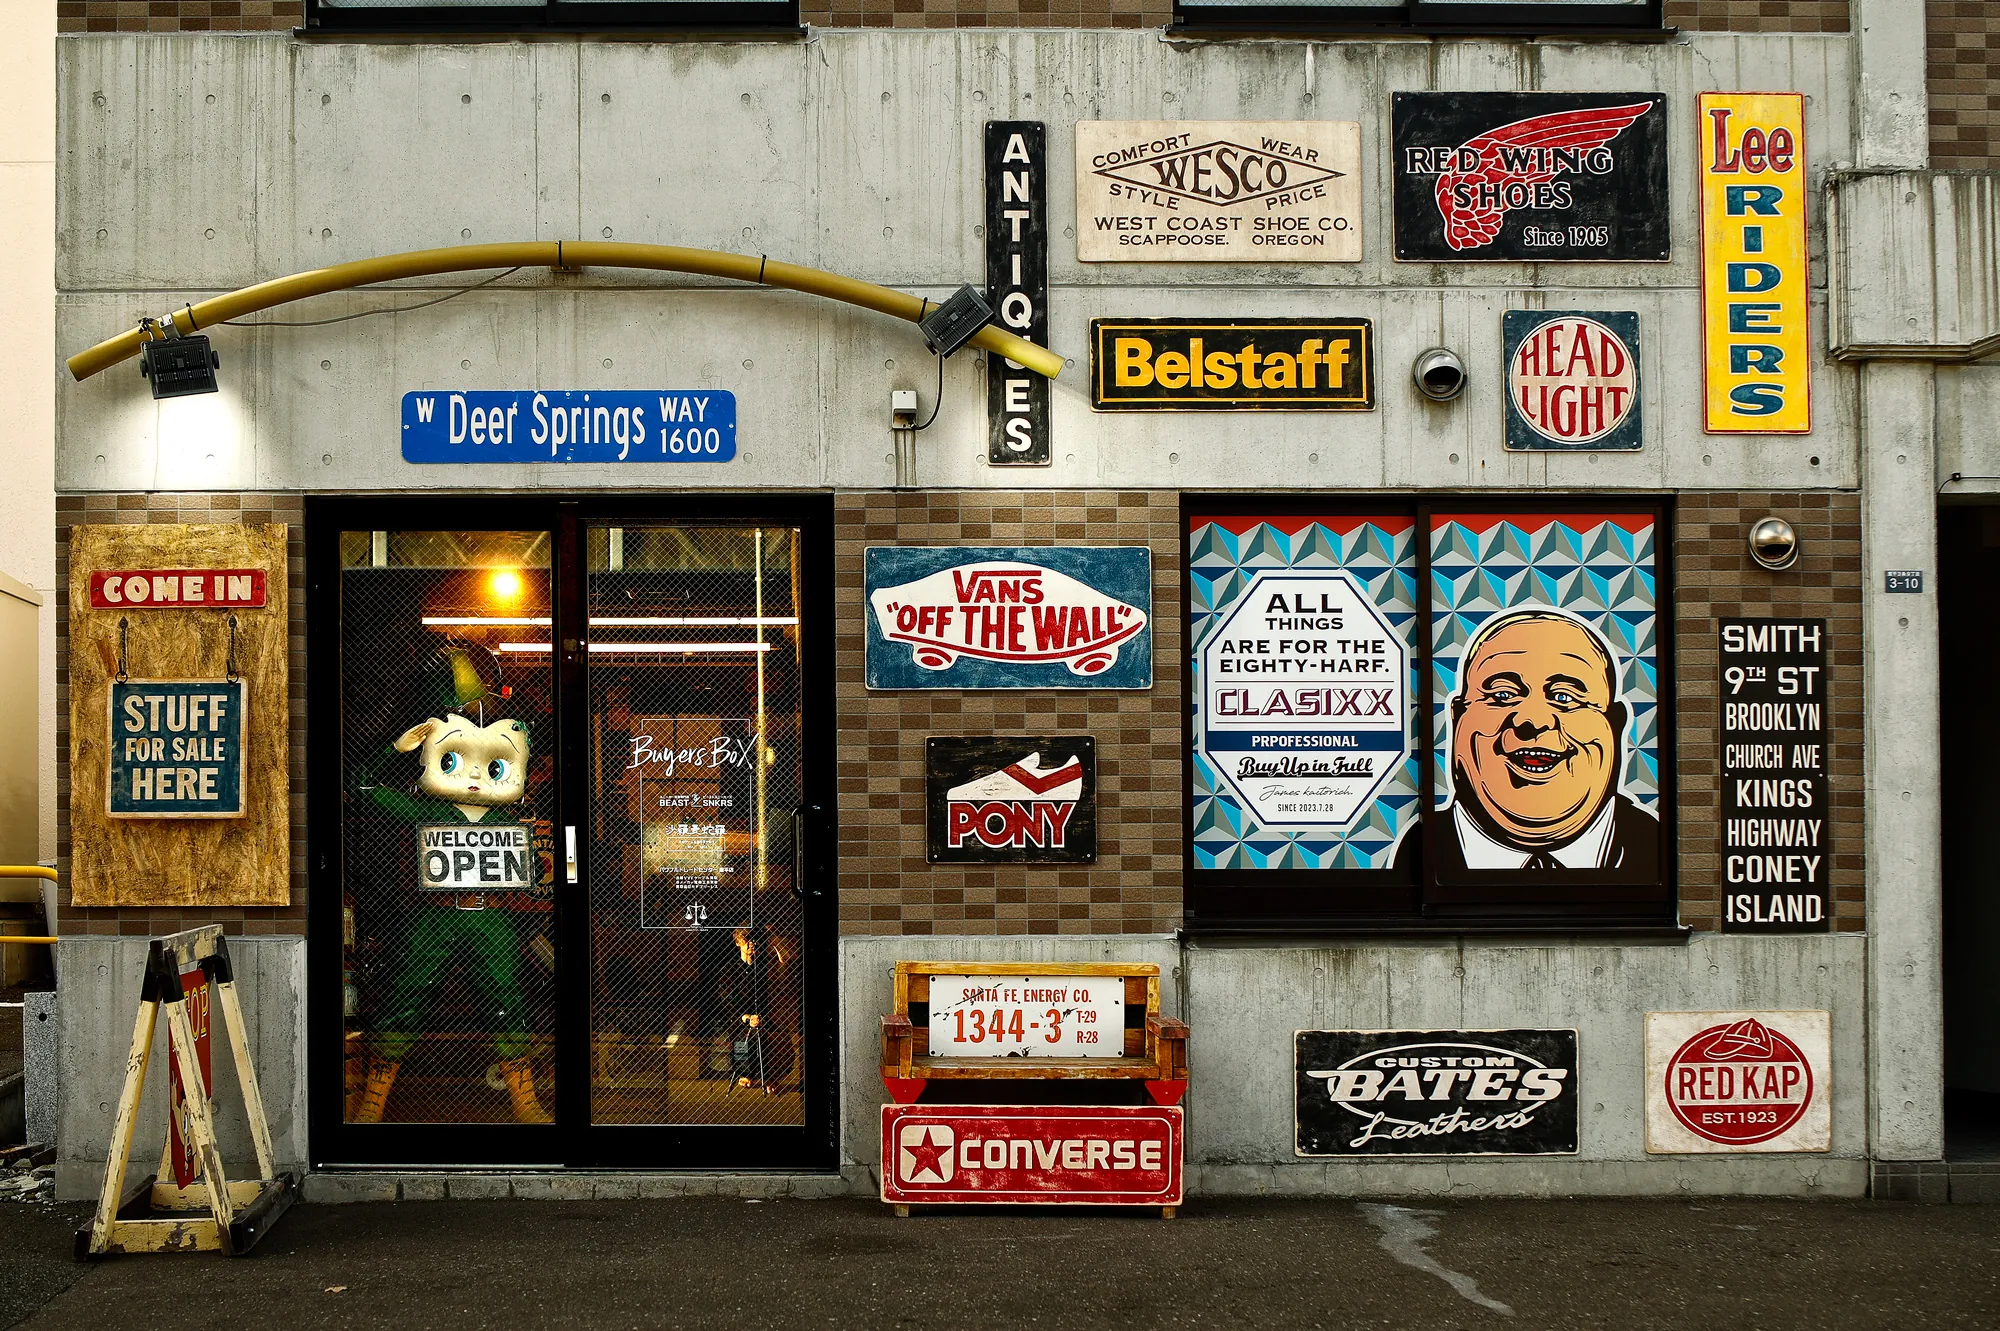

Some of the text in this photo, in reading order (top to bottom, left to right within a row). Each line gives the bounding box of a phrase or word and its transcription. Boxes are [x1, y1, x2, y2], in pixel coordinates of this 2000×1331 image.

[1092, 133, 1319, 168] COMFORT WEAR
[1707, 107, 1796, 175] Lee
[1150, 147, 1288, 200] WESCO
[1405, 146, 1614, 175] RED WING
[1109, 183, 1327, 211] STYLE PRICE
[1453, 181, 1573, 209] SHOES
[1094, 216, 1354, 231] WEST COAST SHOE CO.
[1523, 225, 1609, 247] Since 1905
[1119, 234, 1325, 246] SCAPPOOSE. OREGON
[1001, 133, 1032, 452] ANTIQES
[1725, 184, 1786, 417] RIDERS
[1115, 337, 1350, 389] Belstaff
[1519, 323, 1625, 377] HEAD
[1521, 385, 1629, 438] LIGHT
[416, 392, 710, 461] W Deer Springs WAY
[660, 428, 720, 454] 1600
[102, 574, 252, 603] COME IN
[952, 570, 1045, 605] VANS
[1889, 578, 1919, 589] 3-10
[1265, 593, 1343, 613] ALL
[960, 605, 1027, 652] THE
[1265, 617, 1343, 630] THINGS
[1220, 640, 1385, 654] ARE FOR THE
[1724, 625, 1820, 653] SMITH
[1220, 659, 1390, 673] EIGHTY-HARF.
[1724, 666, 1820, 695] 9TH ST
[123, 694, 228, 733] STUFF
[1215, 688, 1394, 716] CLASIXX
[1726, 702, 1820, 731] BROOKLYN
[125, 737, 226, 762] FOR SALE
[626, 735, 708, 777] Buyers
[1251, 735, 1359, 748] PRPOFESSIONAL
[1726, 744, 1820, 769] CHURCH AVE
[132, 766, 219, 800] HERE
[1736, 779, 1813, 808] KINGS
[659, 799, 733, 807] BEAST SNKRS
[1278, 803, 1334, 812] SINCE 2023.7.28
[424, 831, 523, 847] WELCOME
[948, 800, 1077, 849] PONY
[1727, 819, 1821, 847] HIGHWAY
[423, 849, 528, 882] OPEN
[1727, 855, 1821, 883] CONEY
[1728, 894, 1821, 923] ISLAND
[962, 988, 998, 1003] SANTA
[1023, 988, 1068, 1003] ENERGY
[1073, 988, 1092, 1003] CO.
[1076, 1010, 1097, 1024] T-29
[1076, 1031, 1098, 1044] R-28
[1375, 1056, 1515, 1069] CUSTOM
[1306, 1068, 1568, 1101] BATES
[1678, 1065, 1801, 1100] RED KAP
[1349, 1106, 1534, 1147] Leathers
[960, 1139, 1162, 1170] CONVERSE
